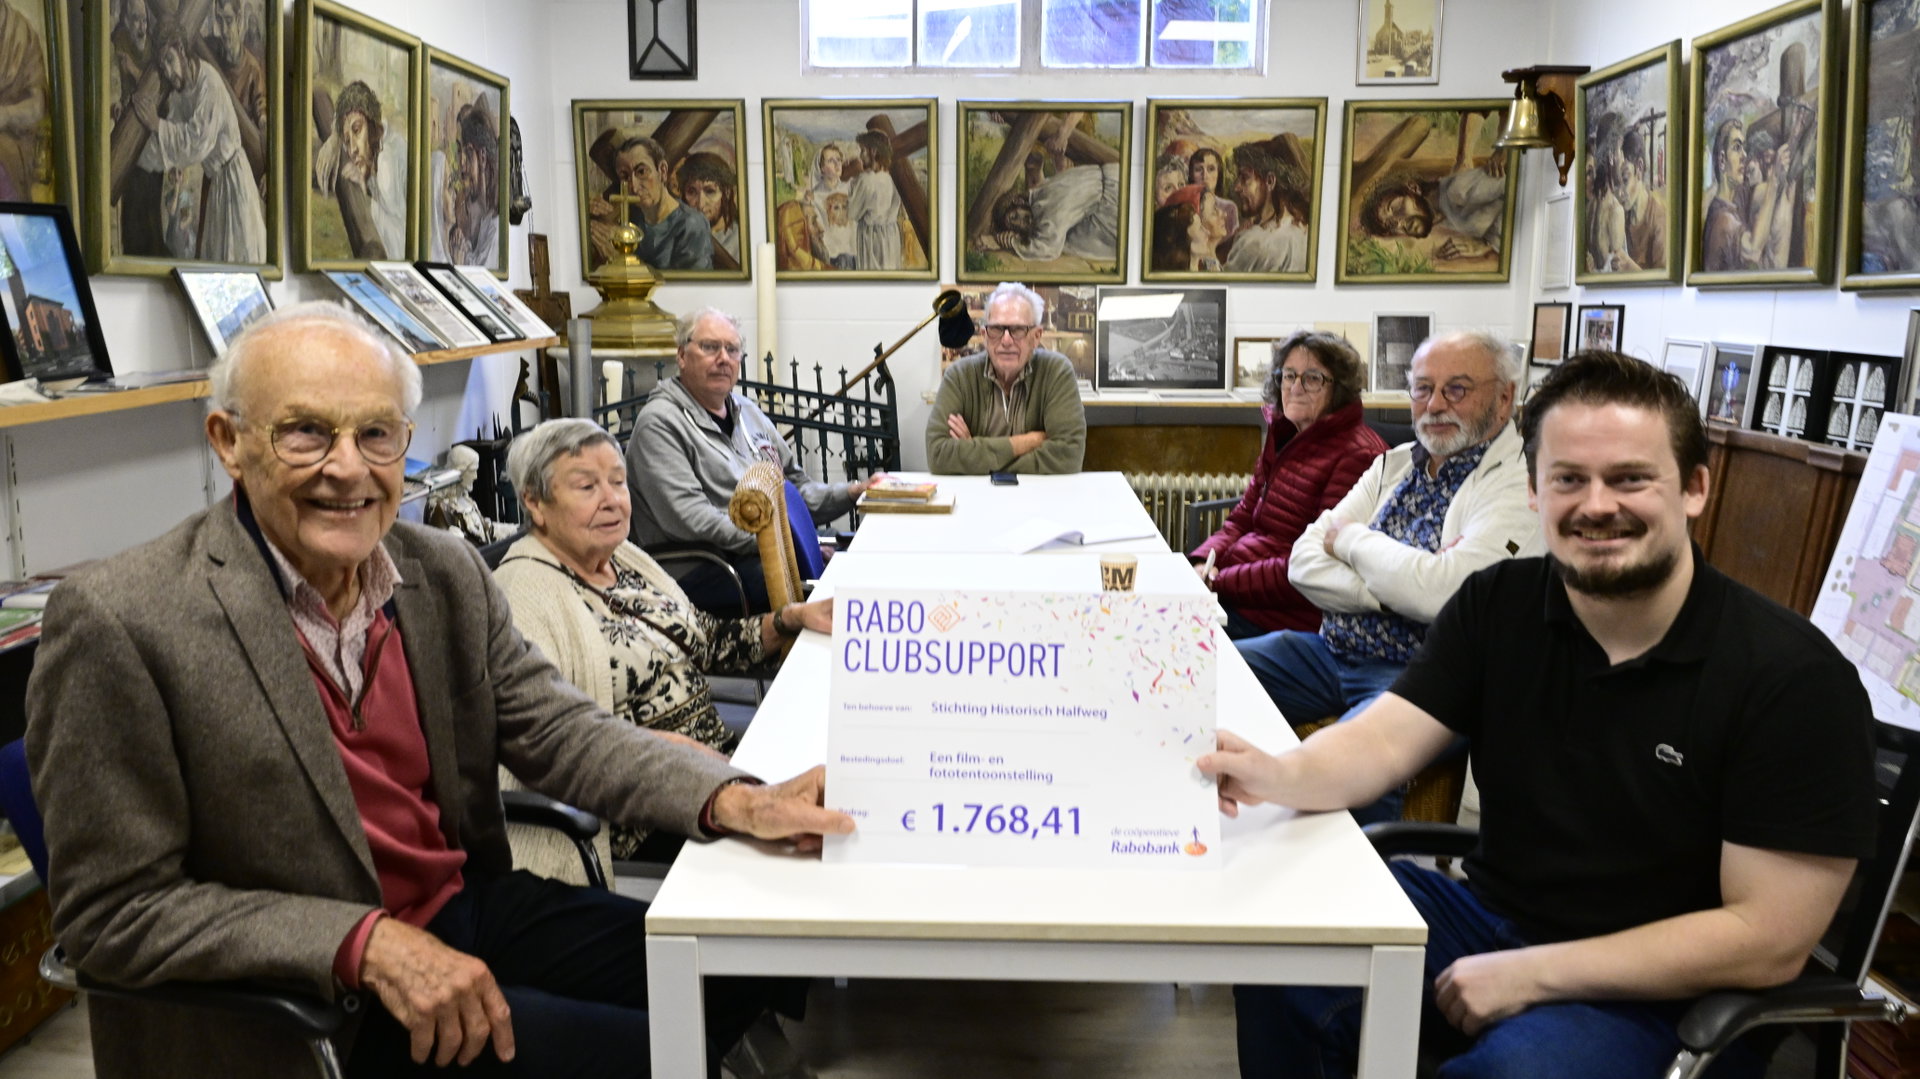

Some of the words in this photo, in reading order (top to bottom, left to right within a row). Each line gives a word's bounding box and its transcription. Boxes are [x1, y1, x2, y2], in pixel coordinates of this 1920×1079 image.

[846, 600, 925, 634] RABO
[844, 638, 1065, 678] CLUBSUPPORT
[843, 702, 857, 711] Ten
[858, 703, 893, 712] behoeve
[931, 701, 988, 718] Stichting
[991, 703, 1053, 717] Historisch
[1056, 705, 1108, 720] Halfweg
[929, 751, 953, 764] Een
[956, 752, 984, 765] film-
[988, 755, 1004, 765] en
[929, 767, 1054, 785] fototentoonstelling
[901, 810, 916, 832] €
[932, 803, 1080, 839] 1.768,41
[1110, 826, 1121, 837] de
[1111, 840, 1181, 854] Rabobank
